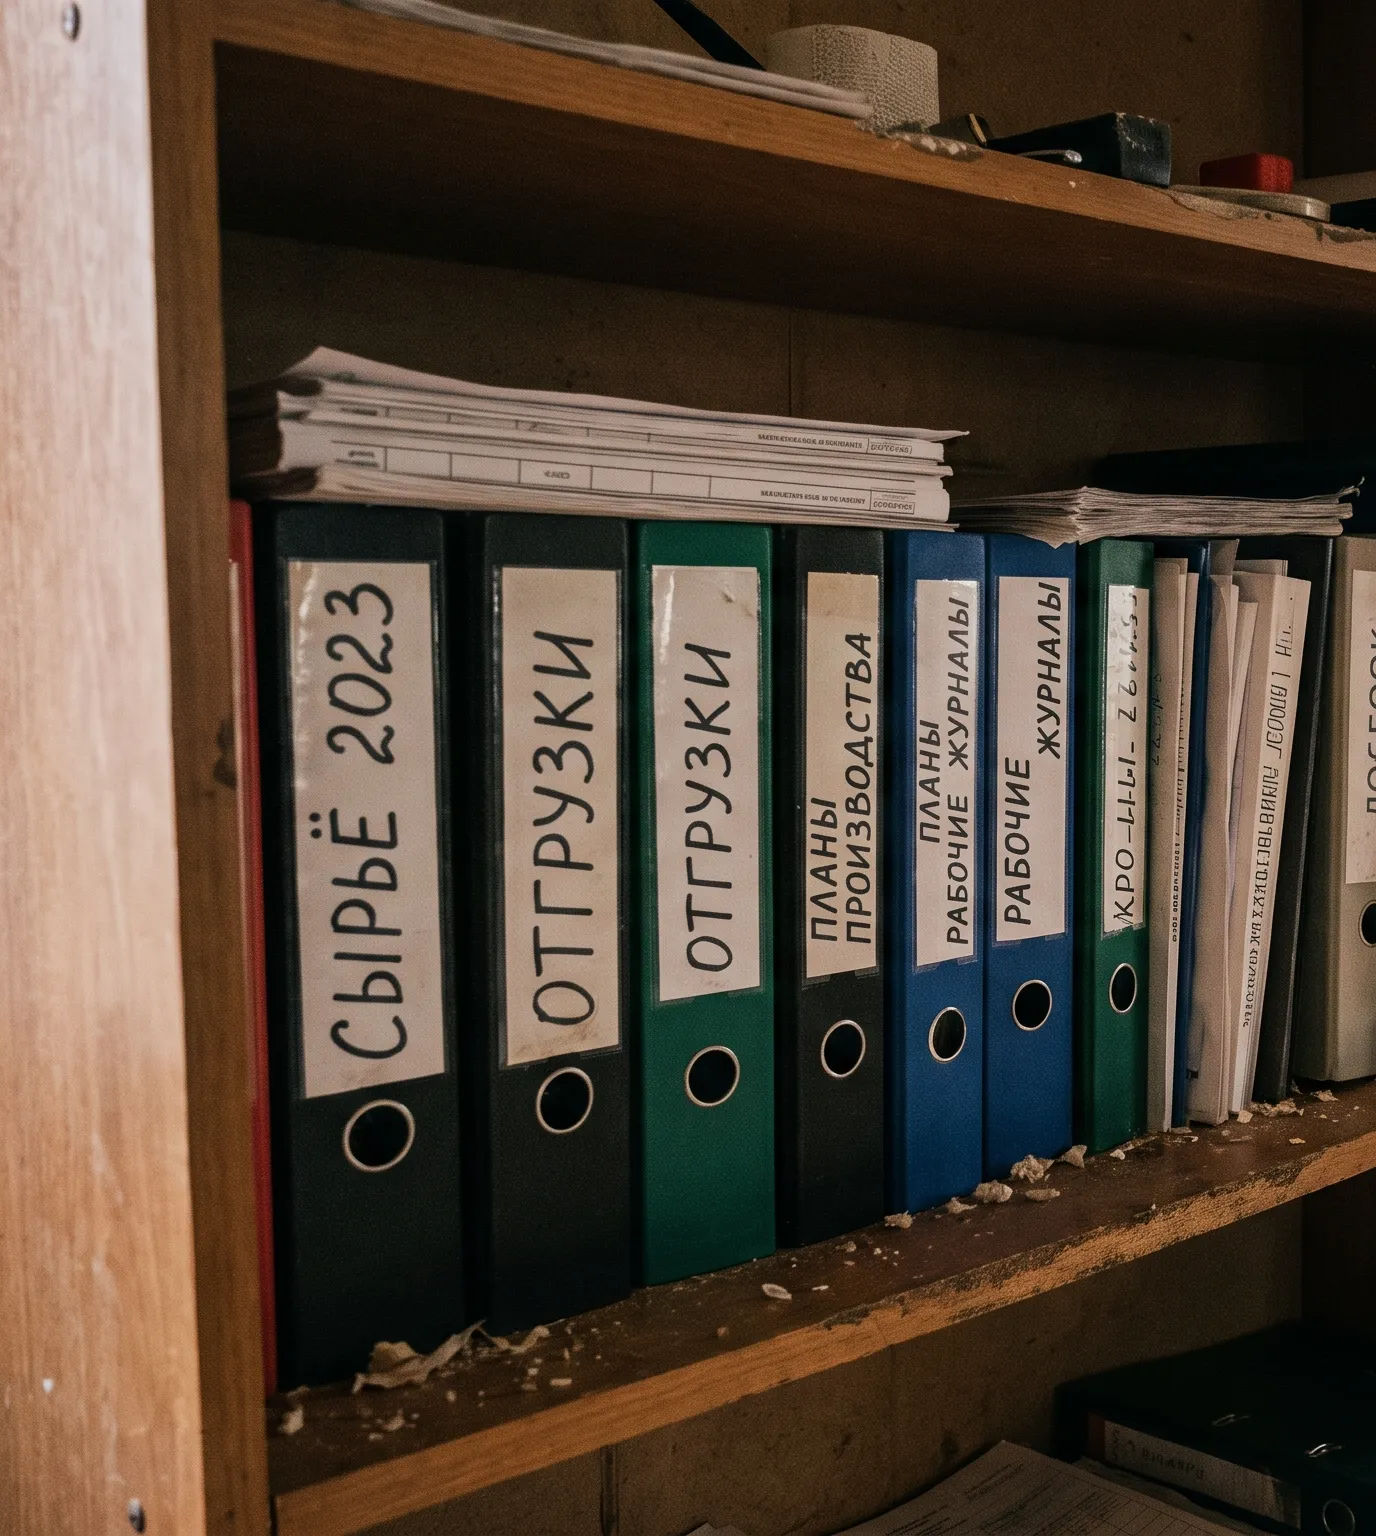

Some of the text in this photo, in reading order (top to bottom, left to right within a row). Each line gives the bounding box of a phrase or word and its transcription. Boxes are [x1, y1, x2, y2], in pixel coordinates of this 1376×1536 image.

[308, 583, 408, 1060] СЫРЬЁ 2023
[684, 642, 733, 972] ОТГРУЗКИ
[844, 632, 874, 944] ПРОИЗВОДСТВА
[919, 719, 940, 844] ПЛАНЫ
[947, 596, 969, 945] РАБОЧИЕ ЖУРНАЛЫ
[1037, 581, 1062, 760] ЖУРНАЛЫ
[532, 630, 595, 1026] ОТГРУЗКИ
[810, 797, 838, 942] ПЛАНЫ
[1004, 756, 1032, 926] РАБОЧИЕ
